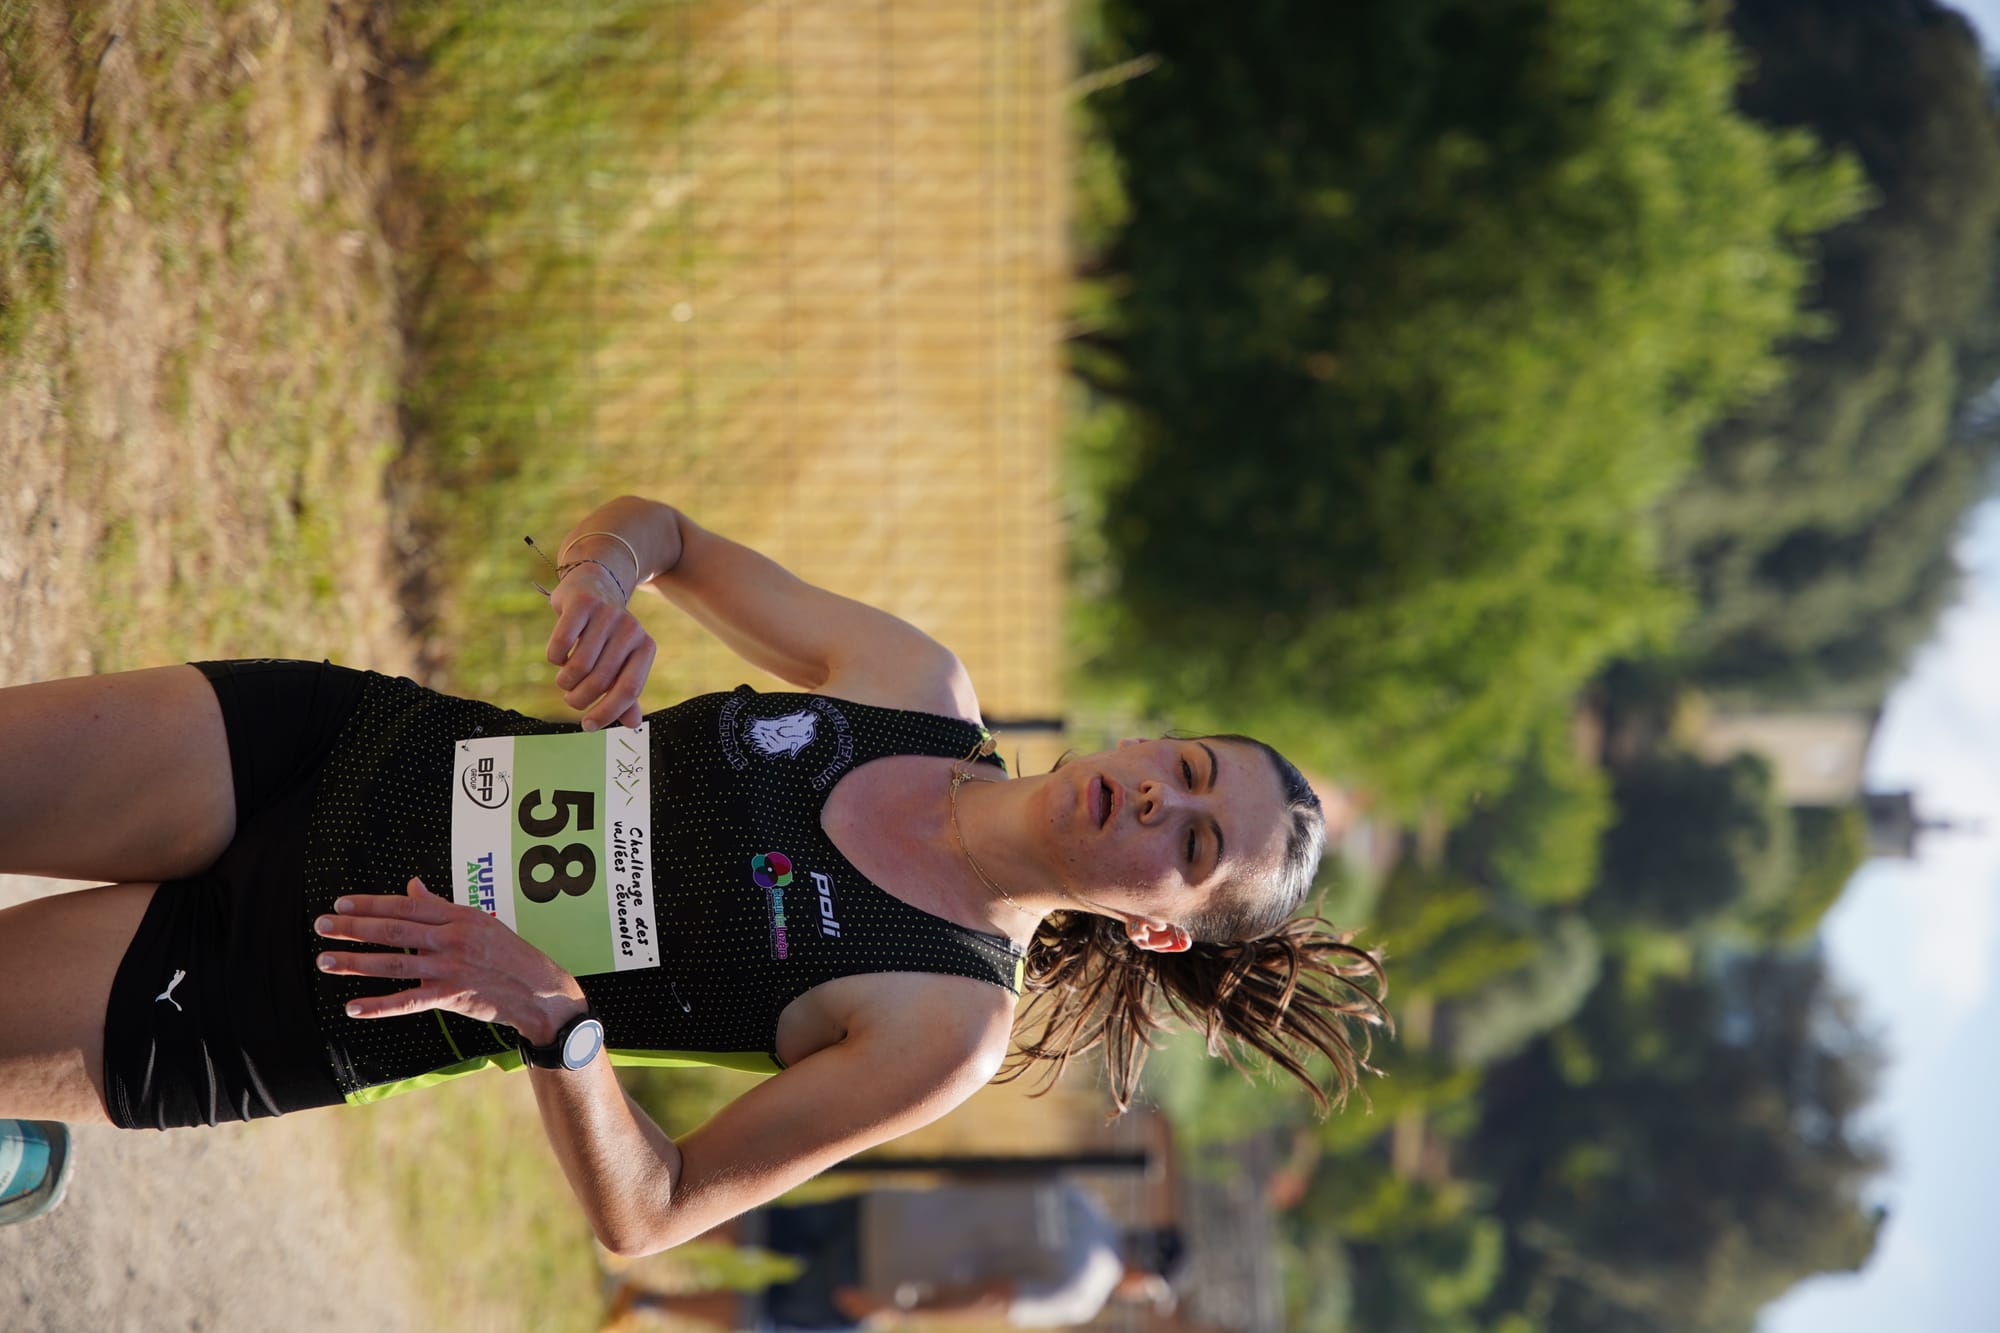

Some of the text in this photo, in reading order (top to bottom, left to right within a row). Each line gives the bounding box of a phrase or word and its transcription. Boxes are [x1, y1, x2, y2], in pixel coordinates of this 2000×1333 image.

[477, 757, 495, 802] BFP
[518, 788, 597, 904] 58
[613, 821, 634, 957] vallées cévenoles
[627, 827, 649, 946] Challenge des
[810, 871, 841, 938] poli
